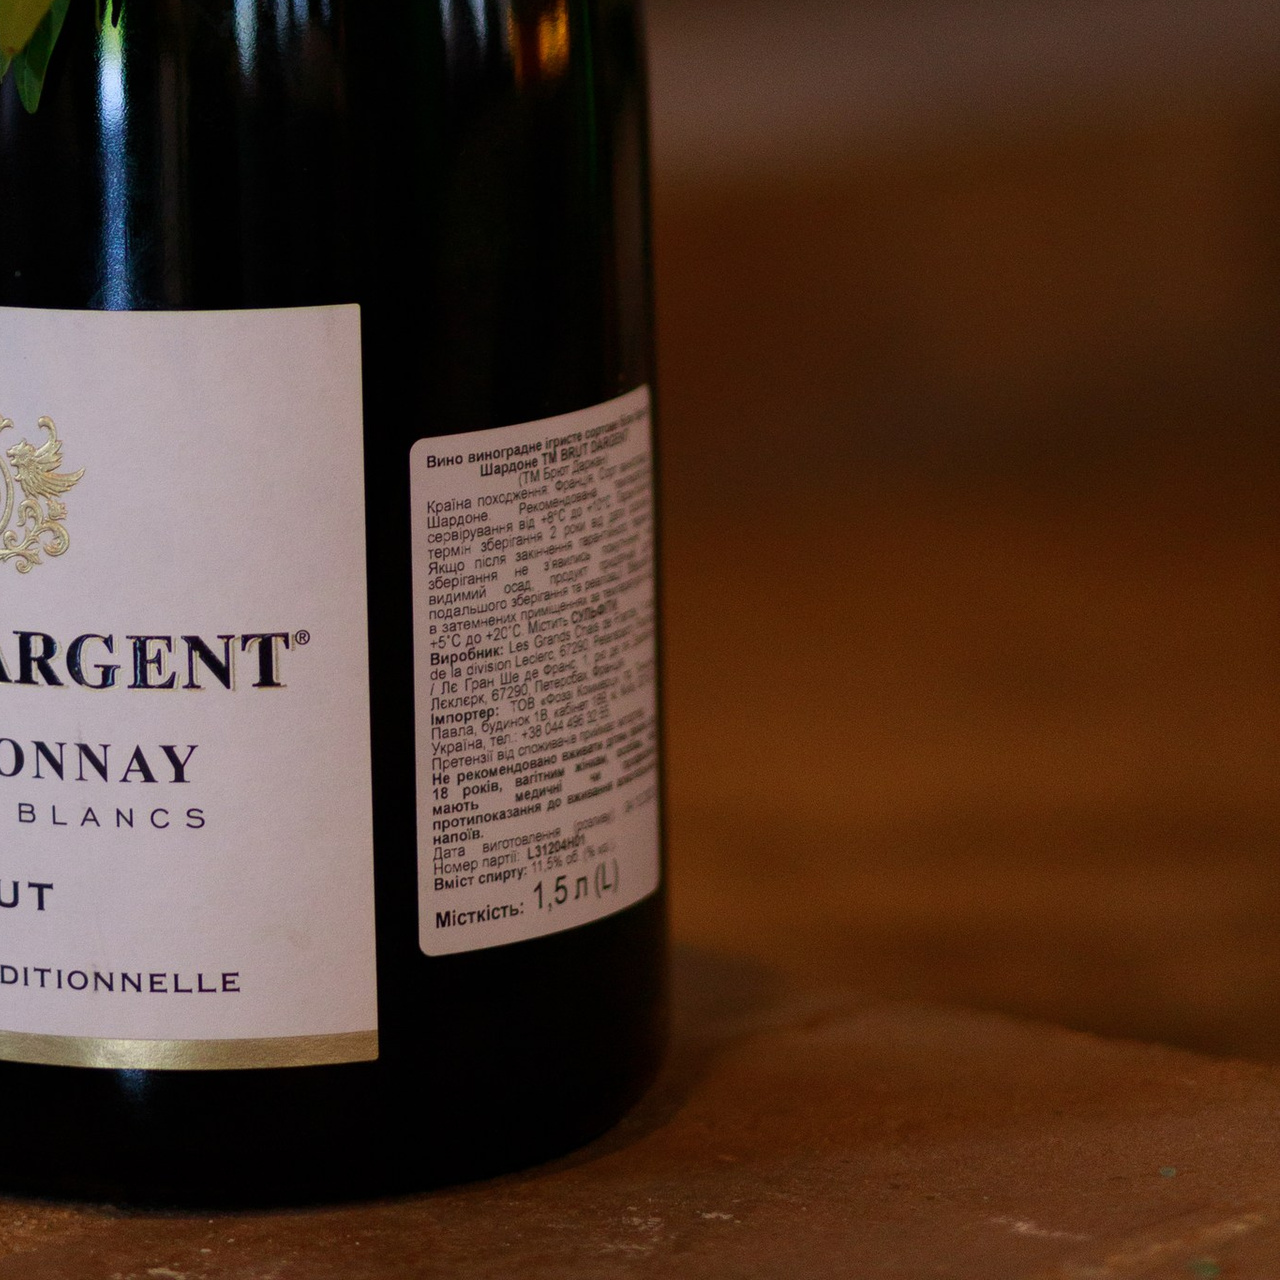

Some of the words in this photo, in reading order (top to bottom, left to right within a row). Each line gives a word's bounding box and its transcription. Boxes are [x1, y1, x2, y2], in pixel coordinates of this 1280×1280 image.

[427, 453, 463, 468] Вино
[467, 440, 541, 462] виноградне
[480, 456, 537, 476] Шардоне
[560, 441, 587, 461] BRUT
[543, 464, 569, 481] Брют
[427, 497, 471, 516] Країна
[427, 522, 512, 545] сервірування
[519, 516, 534, 530] від
[428, 541, 471, 561] термін
[481, 531, 542, 552] зберігання
[550, 525, 556, 539] 2
[428, 560, 464, 575] Якщо
[475, 554, 505, 568] після
[515, 539, 572, 561] закінчення
[428, 570, 497, 590] зберігання
[514, 565, 528, 577] не
[429, 584, 485, 606] видимий
[549, 565, 587, 586] продукт
[429, 599, 506, 621] подальшого
[511, 585, 568, 608] зберігання
[429, 624, 436, 635] в
[442, 612, 515, 633] затемнених
[520, 594, 586, 622] приміщеннях
[430, 645, 503, 665] Виробник:
[509, 639, 528, 653] Les
[534, 628, 570, 648] Grands
[466, 633, 481, 647] до
[430, 666, 445, 681] de
[451, 664, 461, 677] la
[466, 657, 511, 675] division
[442, 680, 457, 694] Лє
[465, 676, 493, 692] Гран
[500, 670, 519, 685] Ше
[524, 668, 538, 682] де
[431, 693, 487, 711] Лєклєрк,
[431, 706, 498, 725] Імпортер:
[510, 695, 534, 713] ТОВ
[431, 724, 476, 740] Павла,
[481, 714, 529, 735] будинок
[431, 737, 485, 756] Україна,
[522, 724, 541, 740] +38
[545, 718, 563, 735] 044
[432, 748, 492, 772] Претензії
[497, 745, 514, 760] від
[432, 772, 449, 786] Не
[456, 754, 556, 785] рекомендовано
[432, 799, 478, 815] мають
[515, 778, 562, 802] медичні
[433, 786, 448, 801] 18
[462, 779, 503, 800] років,
[515, 766, 564, 788] вагітним
[18, 802, 205, 829] BLANCS
[433, 802, 541, 832] протипоказання
[546, 797, 561, 812] до
[433, 827, 483, 845] напоїв.
[433, 845, 465, 862] Дата
[482, 826, 560, 852] виготовлення
[433, 859, 478, 875] Номер
[482, 849, 519, 869] партії:
[434, 874, 474, 891] Вміст
[477, 866, 527, 884] спирту:
[434, 899, 524, 929] Місткість:
[533, 874, 568, 915] 1,5
[573, 874, 588, 900] л
[593, 855, 619, 900] (L)
